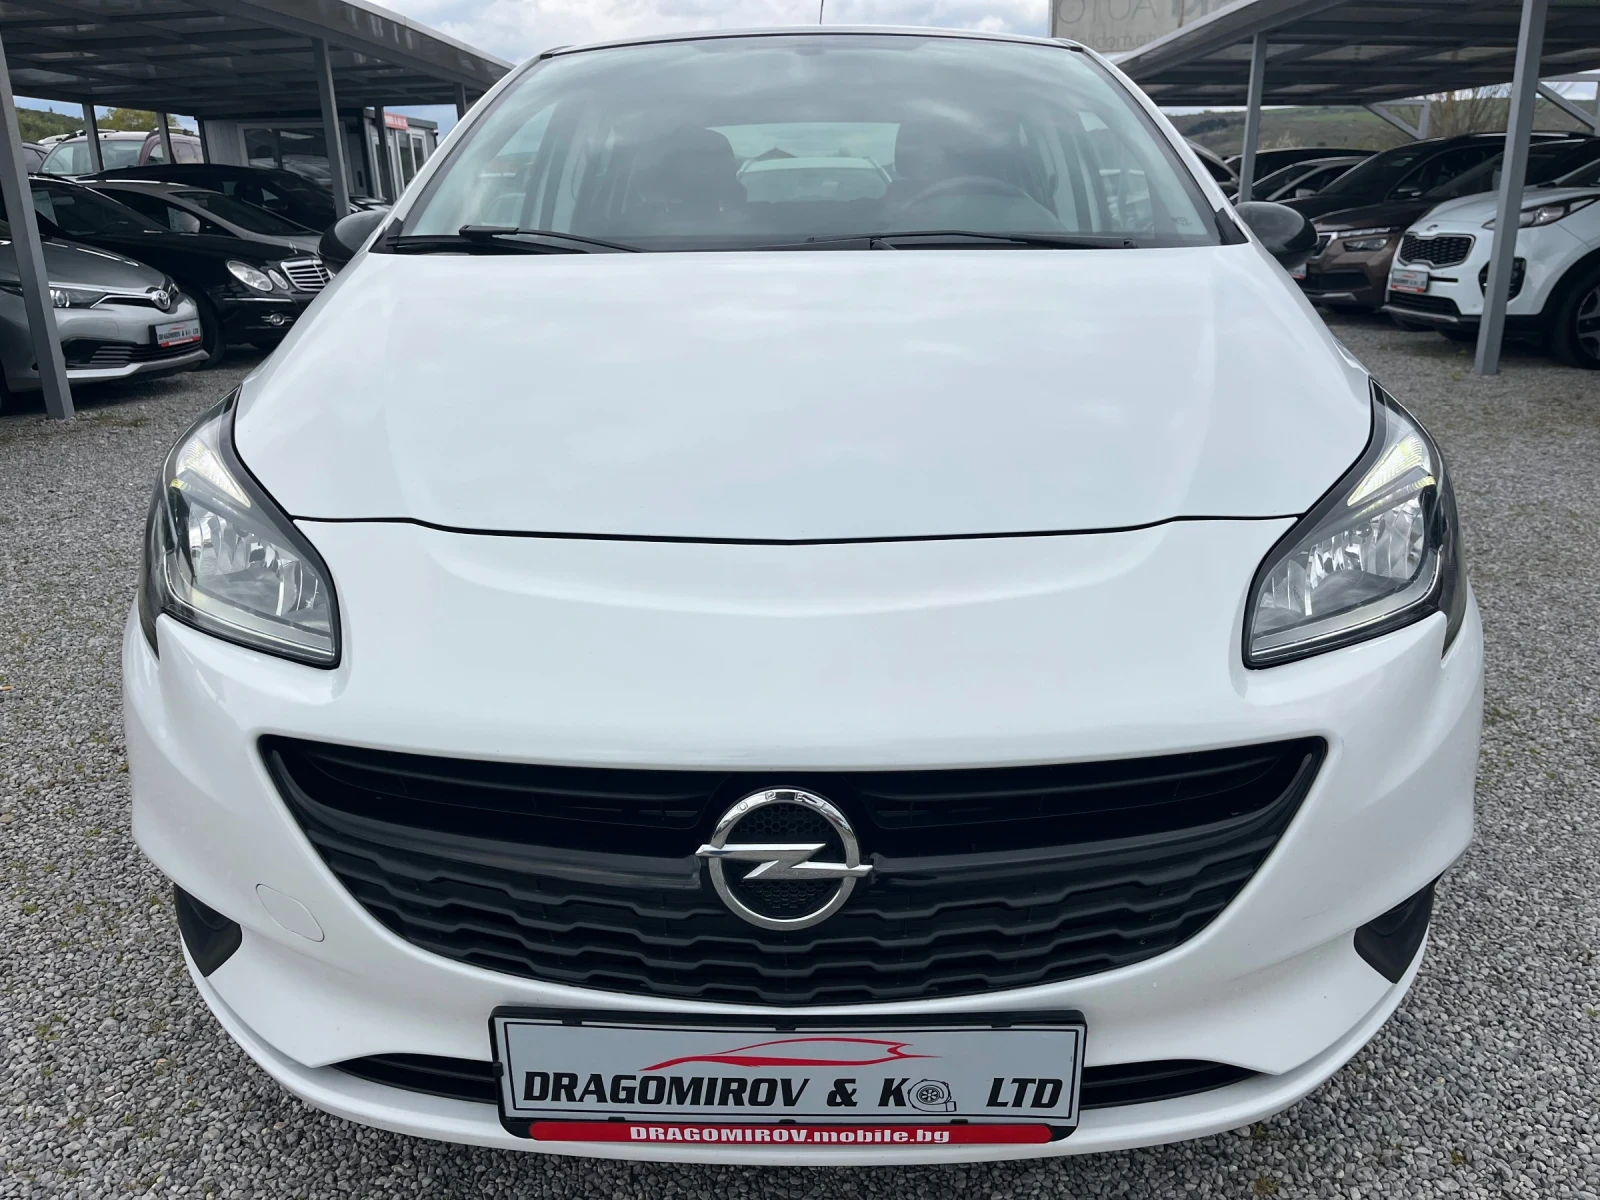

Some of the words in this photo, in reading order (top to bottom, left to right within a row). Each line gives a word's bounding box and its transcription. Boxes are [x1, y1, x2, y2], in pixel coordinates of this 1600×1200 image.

[737, 791, 829, 814] OPEL
[523, 1071, 810, 1107] DRAGOMIROV
[826, 1078, 858, 1107] &
[986, 1078, 1063, 1108] LTD
[630, 1127, 950, 1143] DRAGOMIROV.mobile.bg
